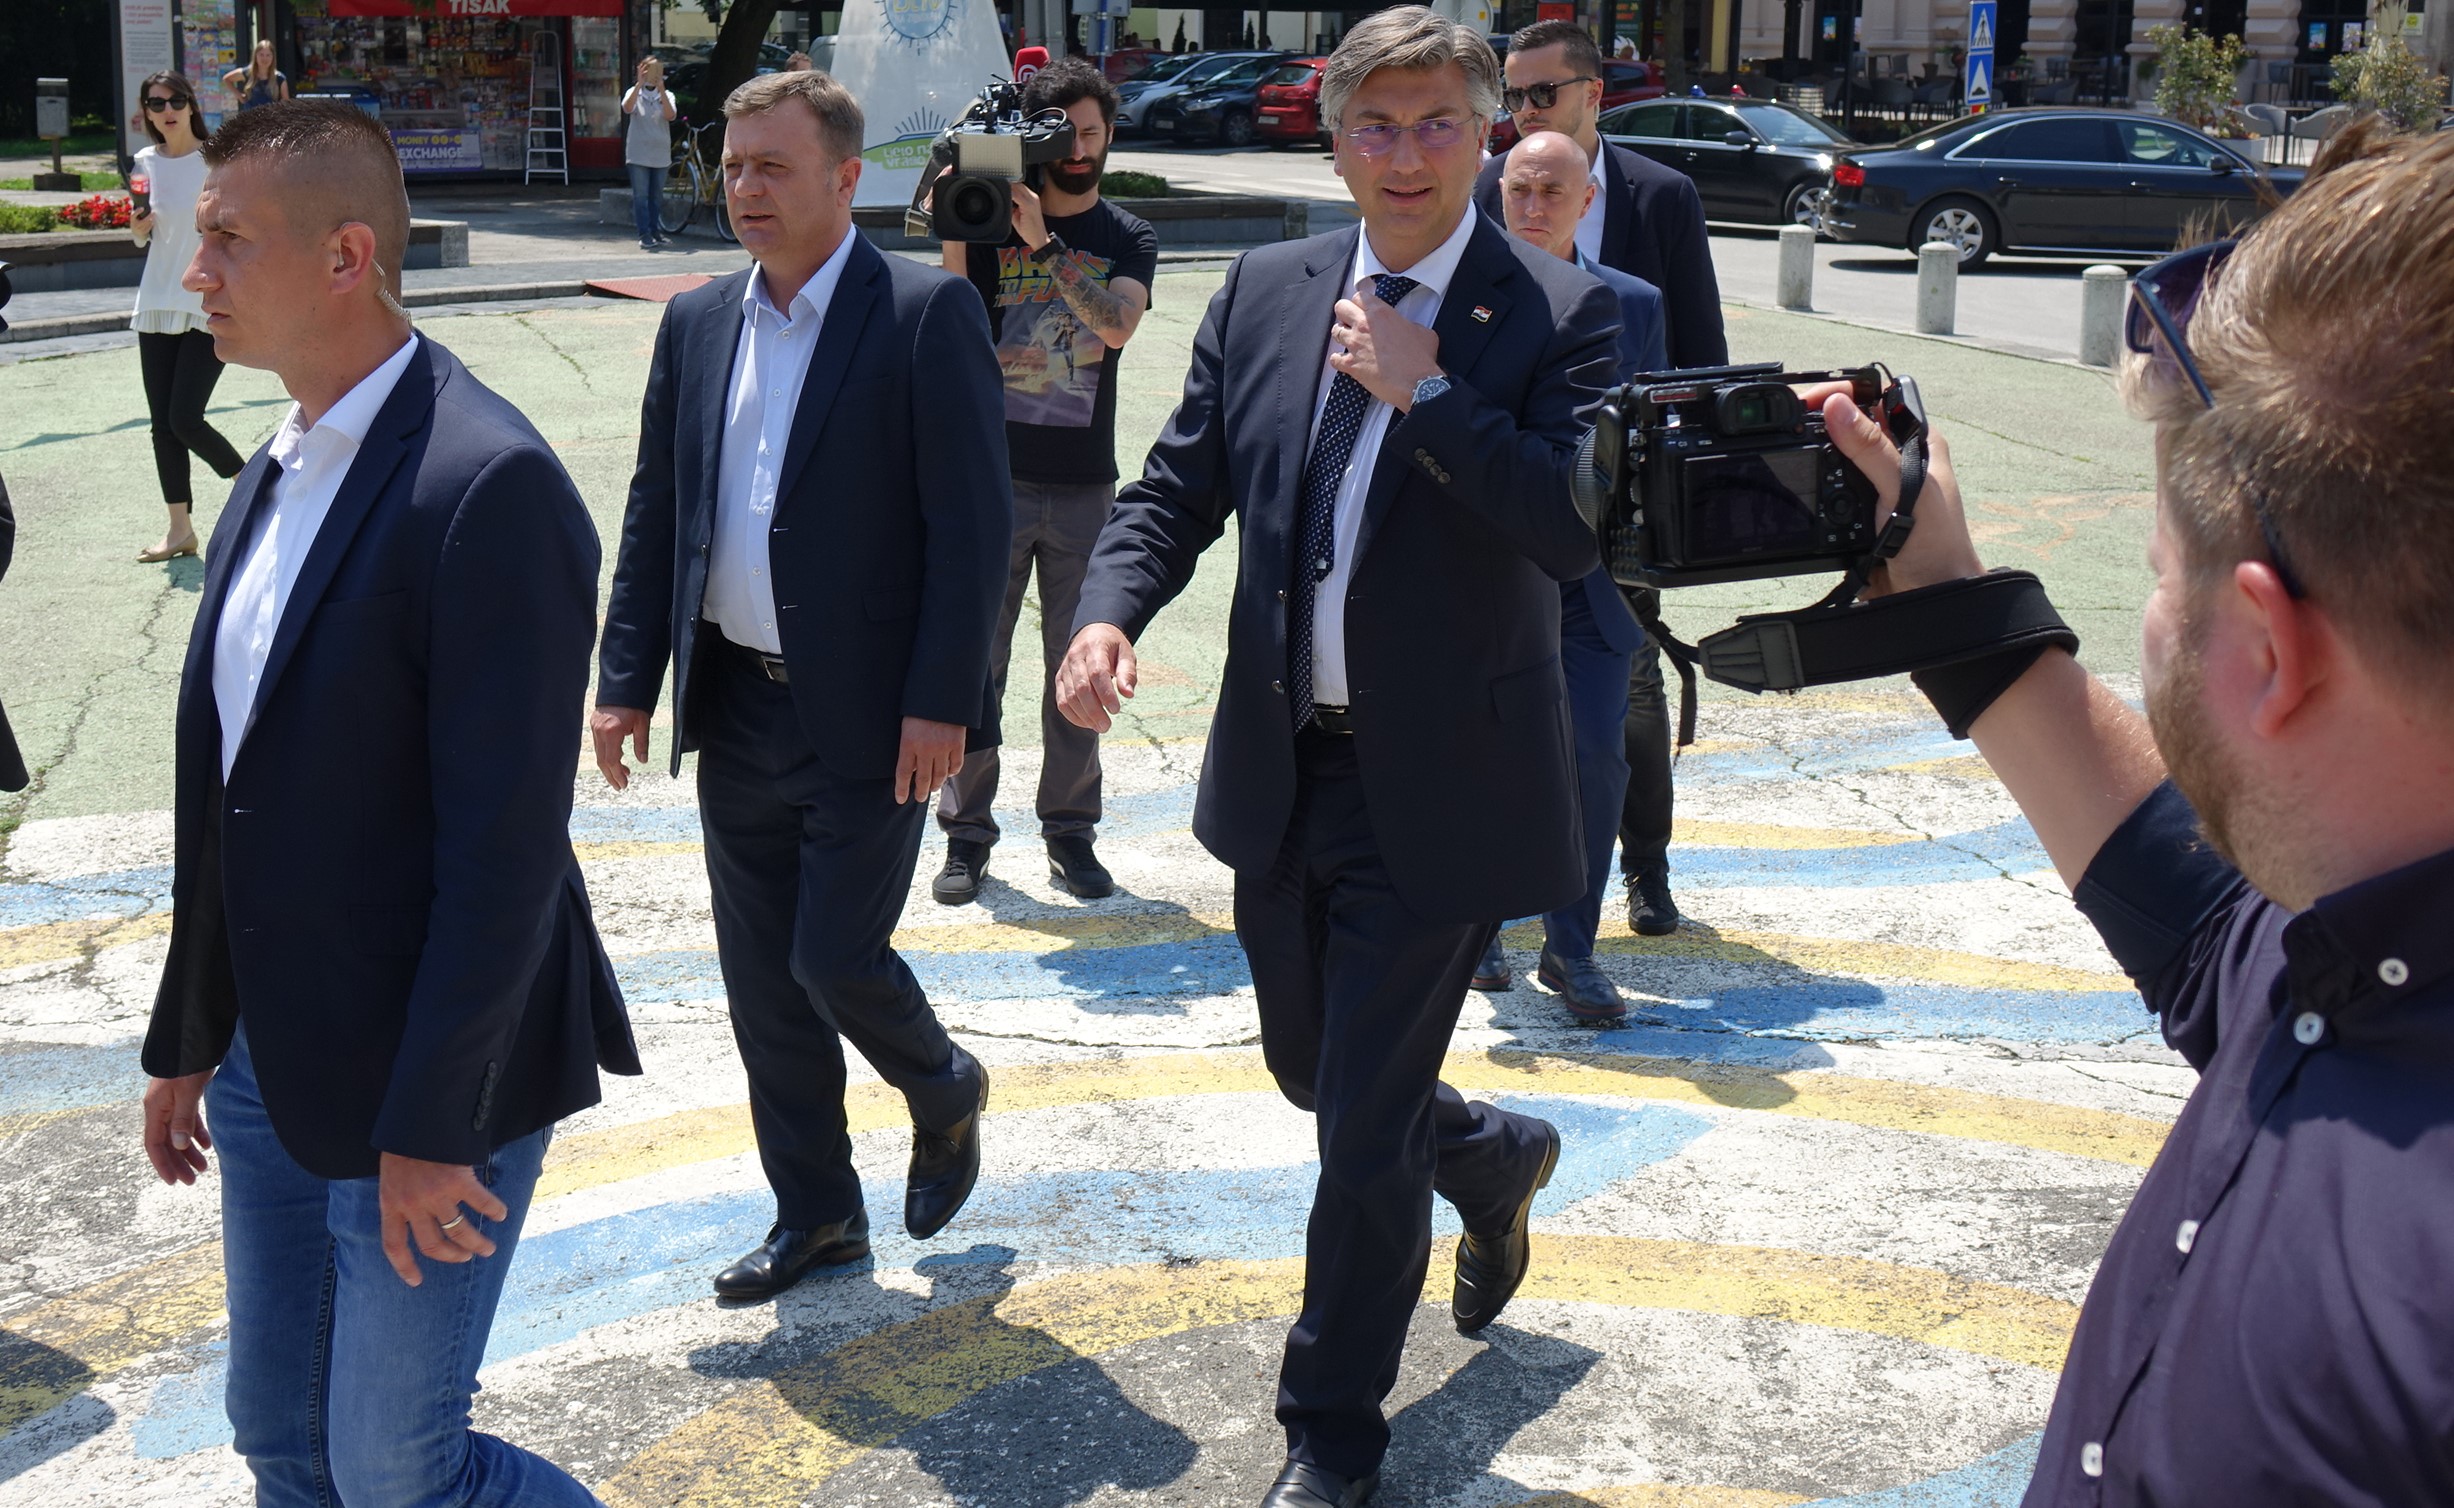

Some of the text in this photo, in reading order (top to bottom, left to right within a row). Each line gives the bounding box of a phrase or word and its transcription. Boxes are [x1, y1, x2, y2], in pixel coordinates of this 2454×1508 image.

[449, 0, 510, 14] TISAK
[397, 136, 428, 145] MONEY
[399, 147, 464, 159] EXCHANGE
